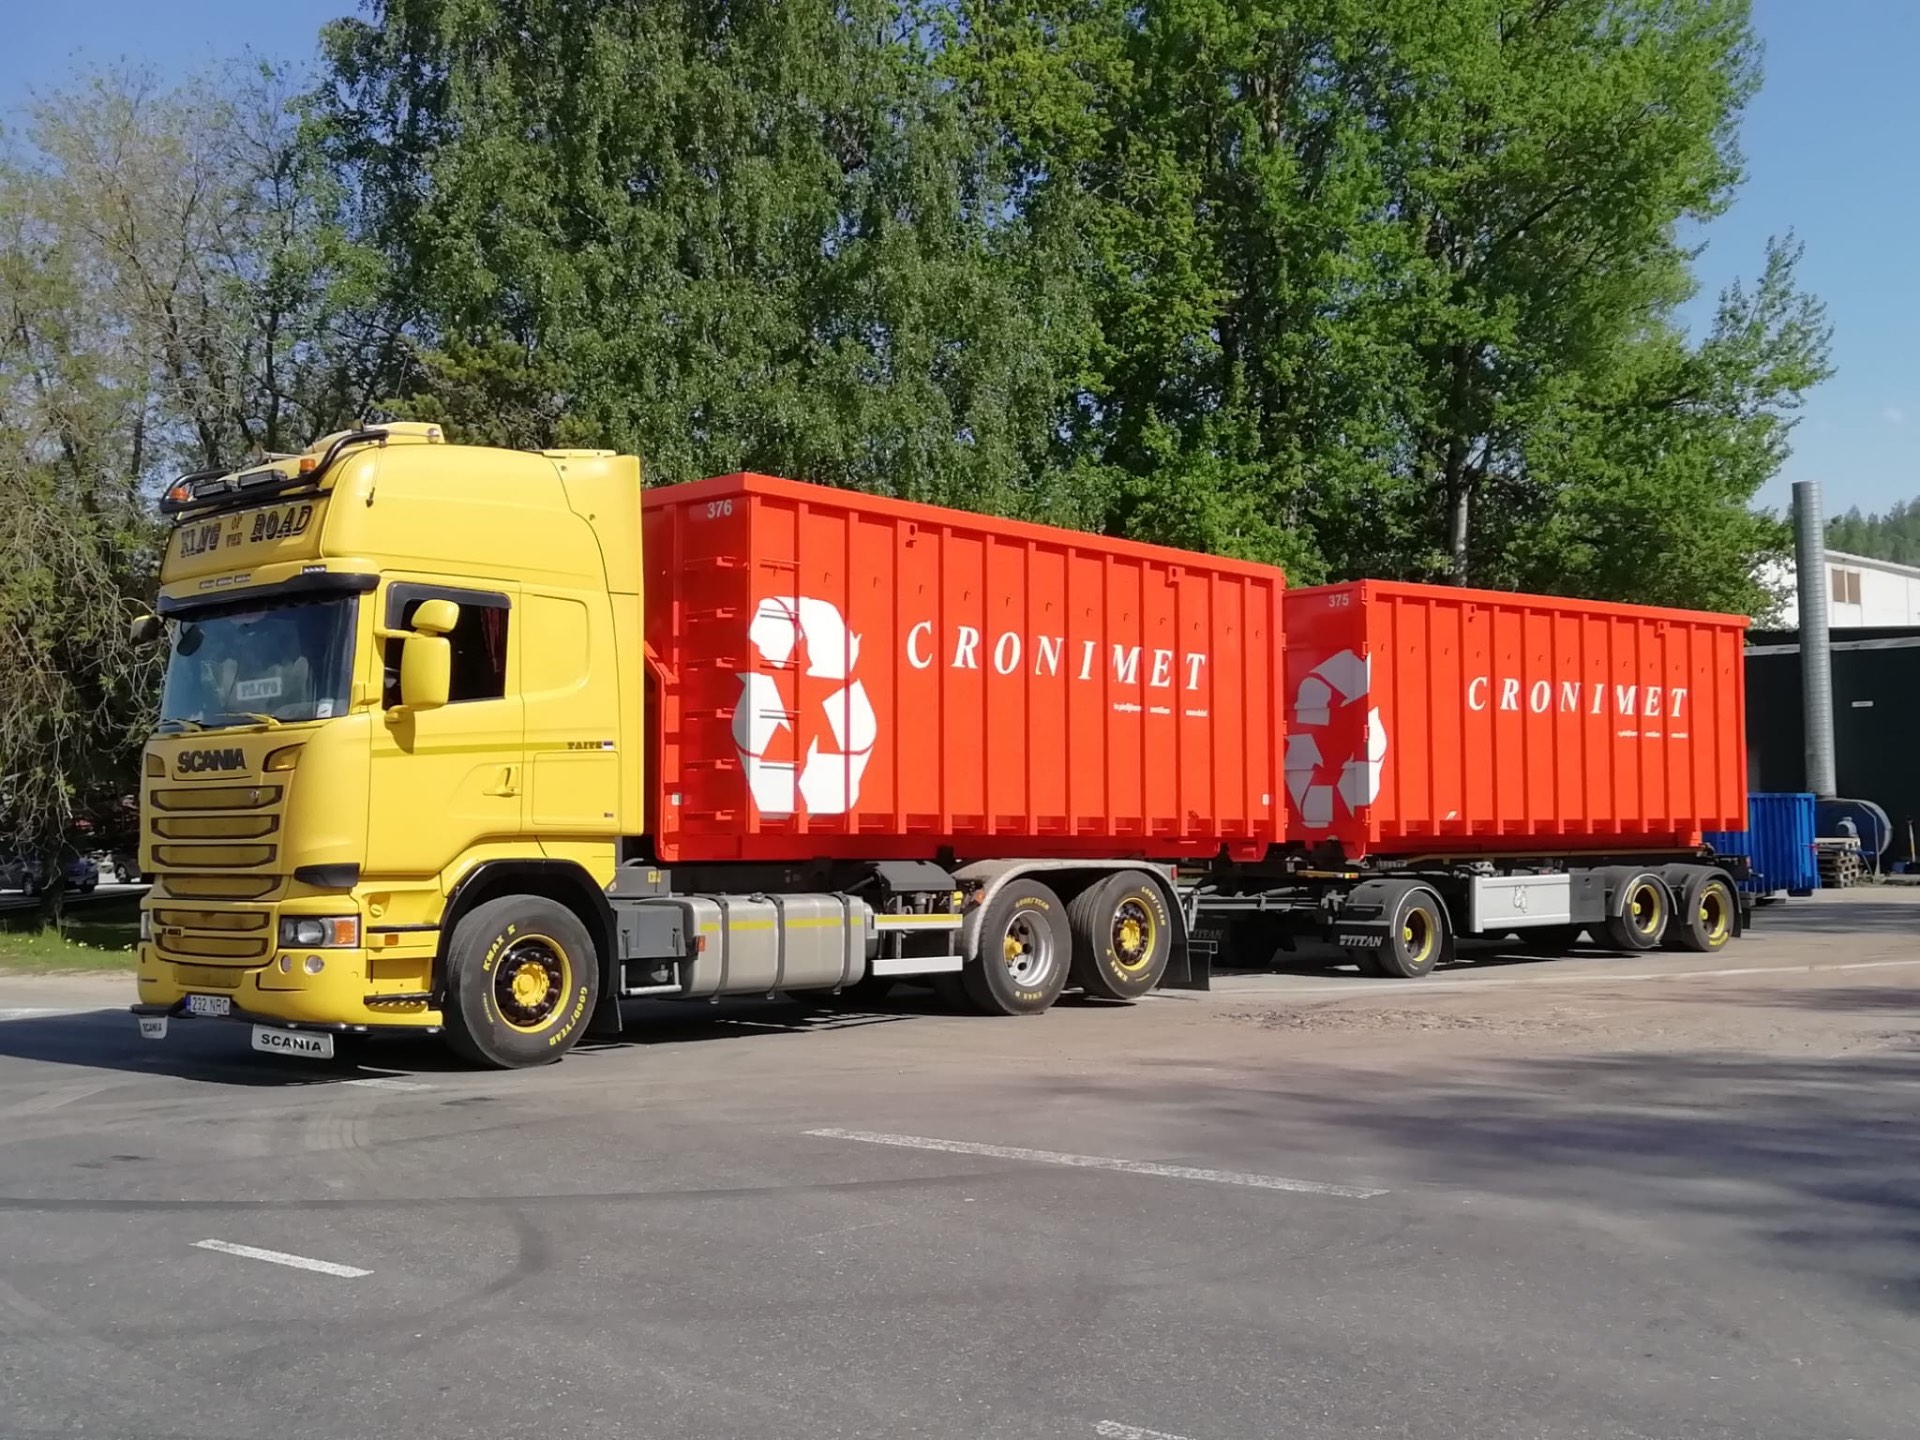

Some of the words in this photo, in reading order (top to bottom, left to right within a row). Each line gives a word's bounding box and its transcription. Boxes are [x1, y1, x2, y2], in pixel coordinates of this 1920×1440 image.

[250, 506, 312, 542] ROAD
[707, 499, 732, 519] 376
[1328, 593, 1350, 607] 375
[907, 620, 1206, 690] CRONIMET
[1468, 676, 1688, 717] CRONIMET
[177, 748, 247, 773] SCANIA
[483, 935, 504, 971] KMAX
[1340, 935, 1383, 947] TITAN
[549, 986, 587, 1045] GOODYEAR
[261, 1033, 323, 1052] SCANIA
